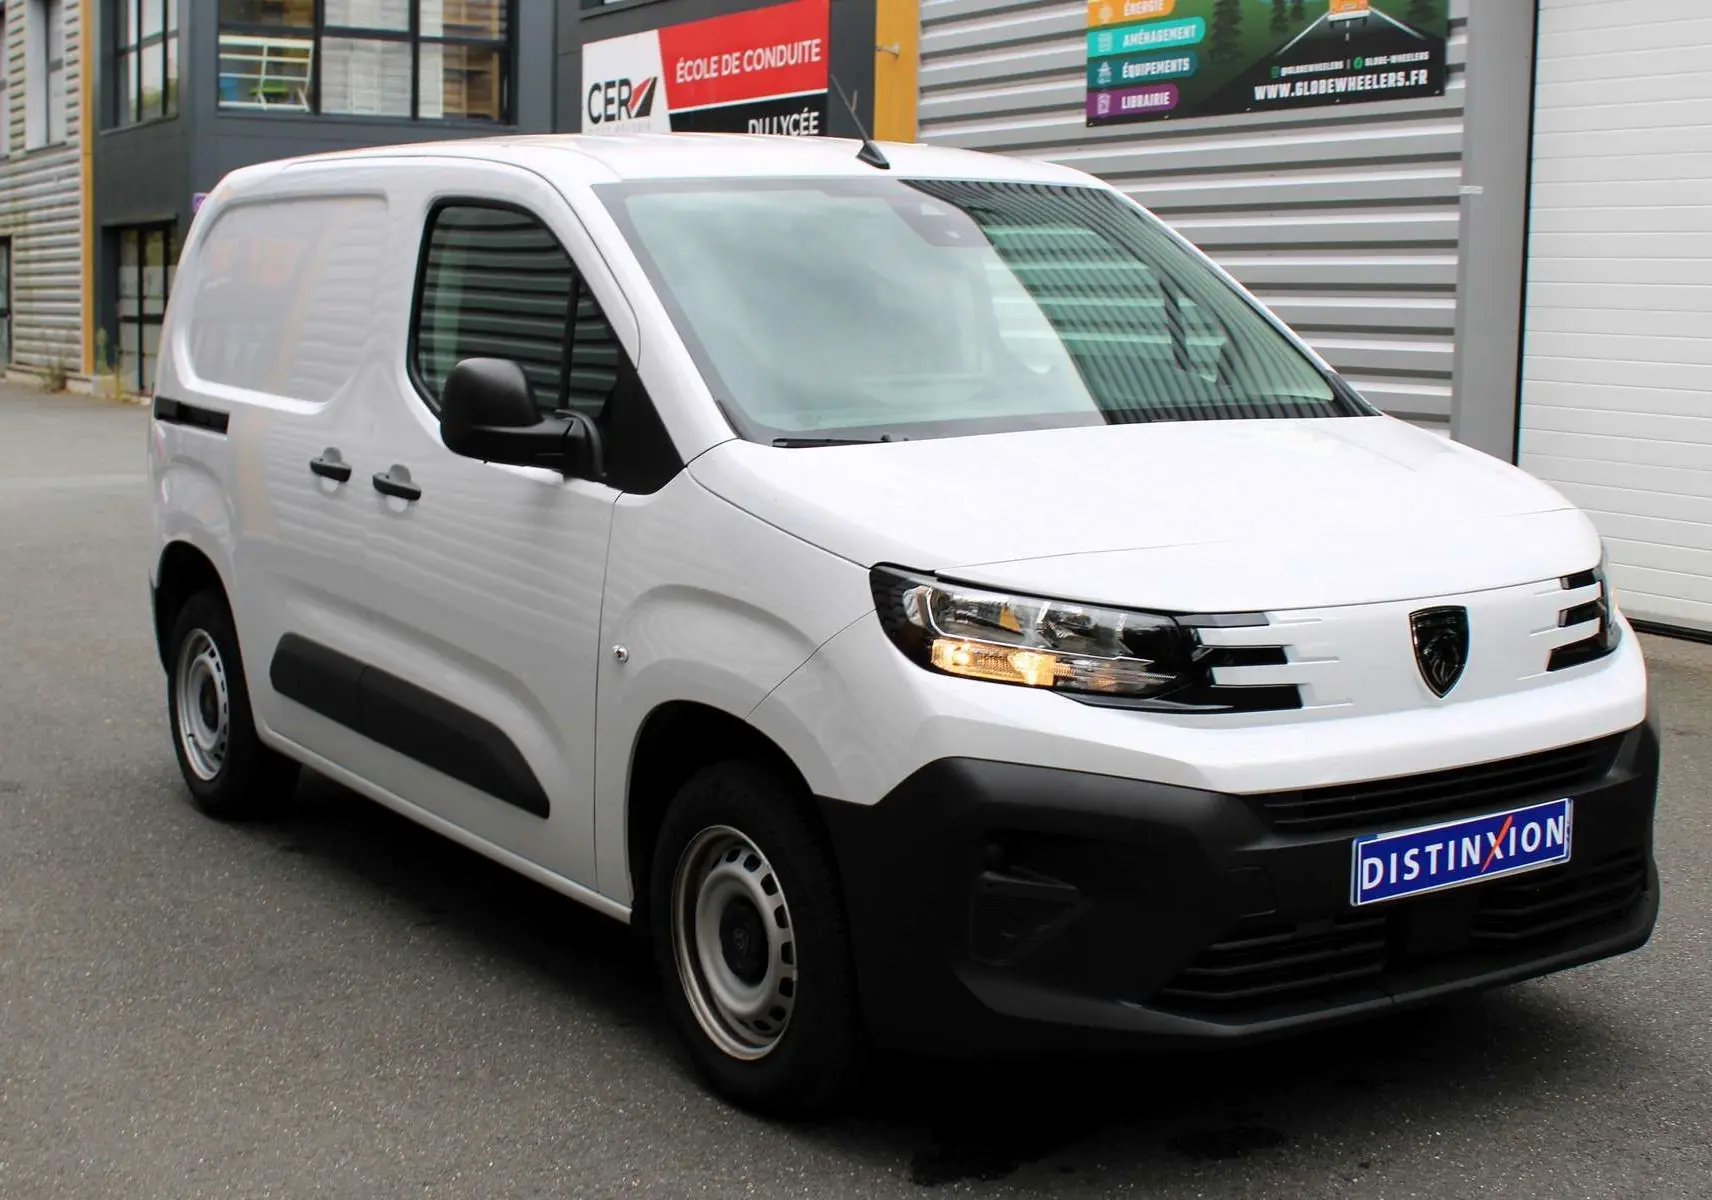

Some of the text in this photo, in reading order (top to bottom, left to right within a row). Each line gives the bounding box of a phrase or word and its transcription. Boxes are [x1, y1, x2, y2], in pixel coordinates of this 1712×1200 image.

[1123, 25, 1197, 48] AMÉNAGEMENT
[676, 38, 821, 83] ÉCOLE DE CONDUITE
[1122, 57, 1190, 79] ÉQUIPEMENTS
[1254, 69, 1428, 100] WWW.GLOBEWHEELERS.FR
[588, 78, 632, 124] CER
[1121, 92, 1170, 109] LIBRAIRIE
[1362, 815, 1564, 890] DISTINXION
